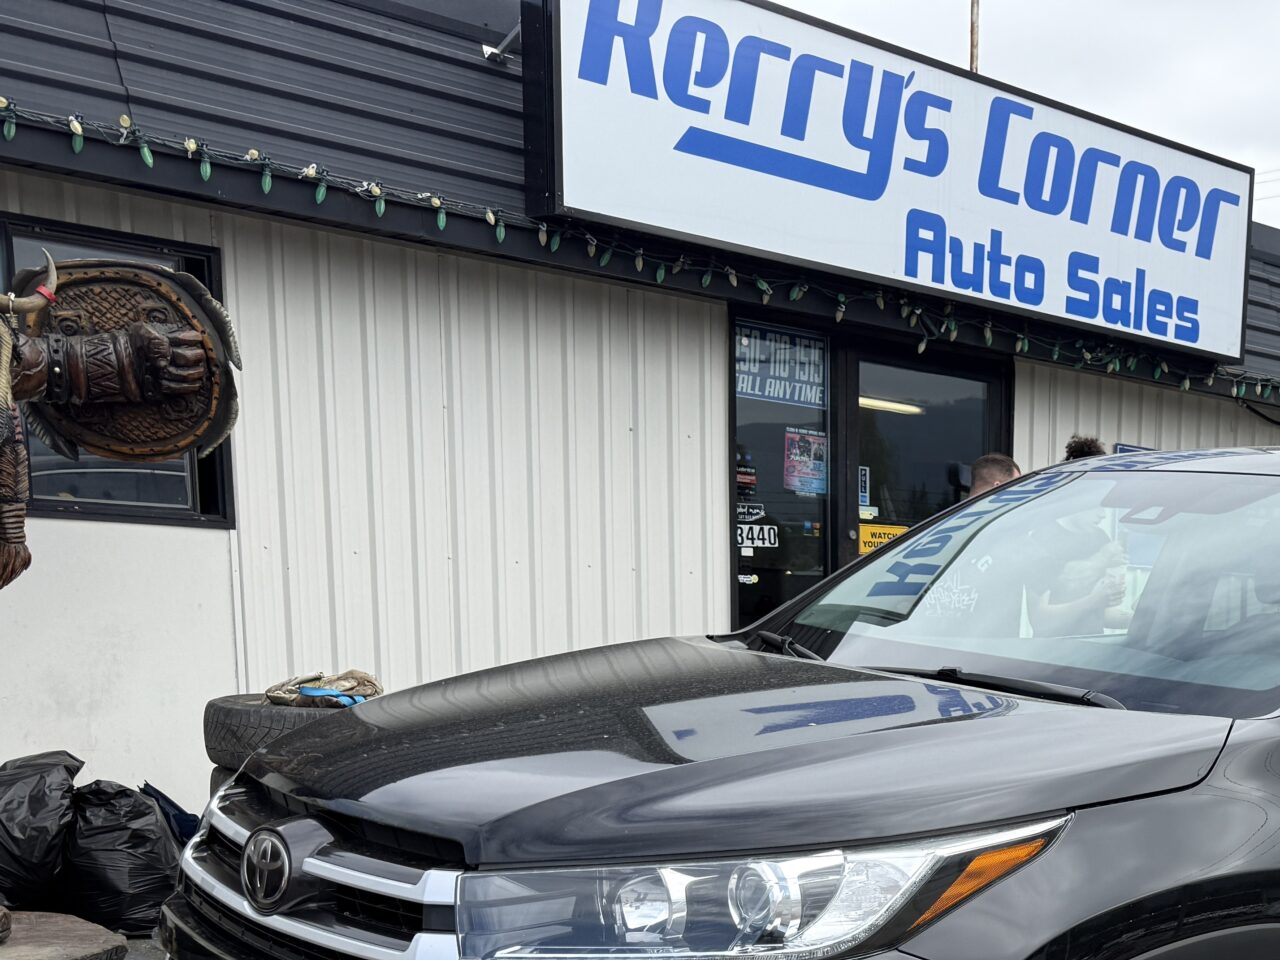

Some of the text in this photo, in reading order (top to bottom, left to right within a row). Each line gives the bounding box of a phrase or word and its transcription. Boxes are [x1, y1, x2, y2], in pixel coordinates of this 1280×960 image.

[577, 0, 1241, 260] Kerry's Corner
[904, 208, 1200, 343] Auto Sales
[736, 373, 824, 404] ALL ANYTIME
